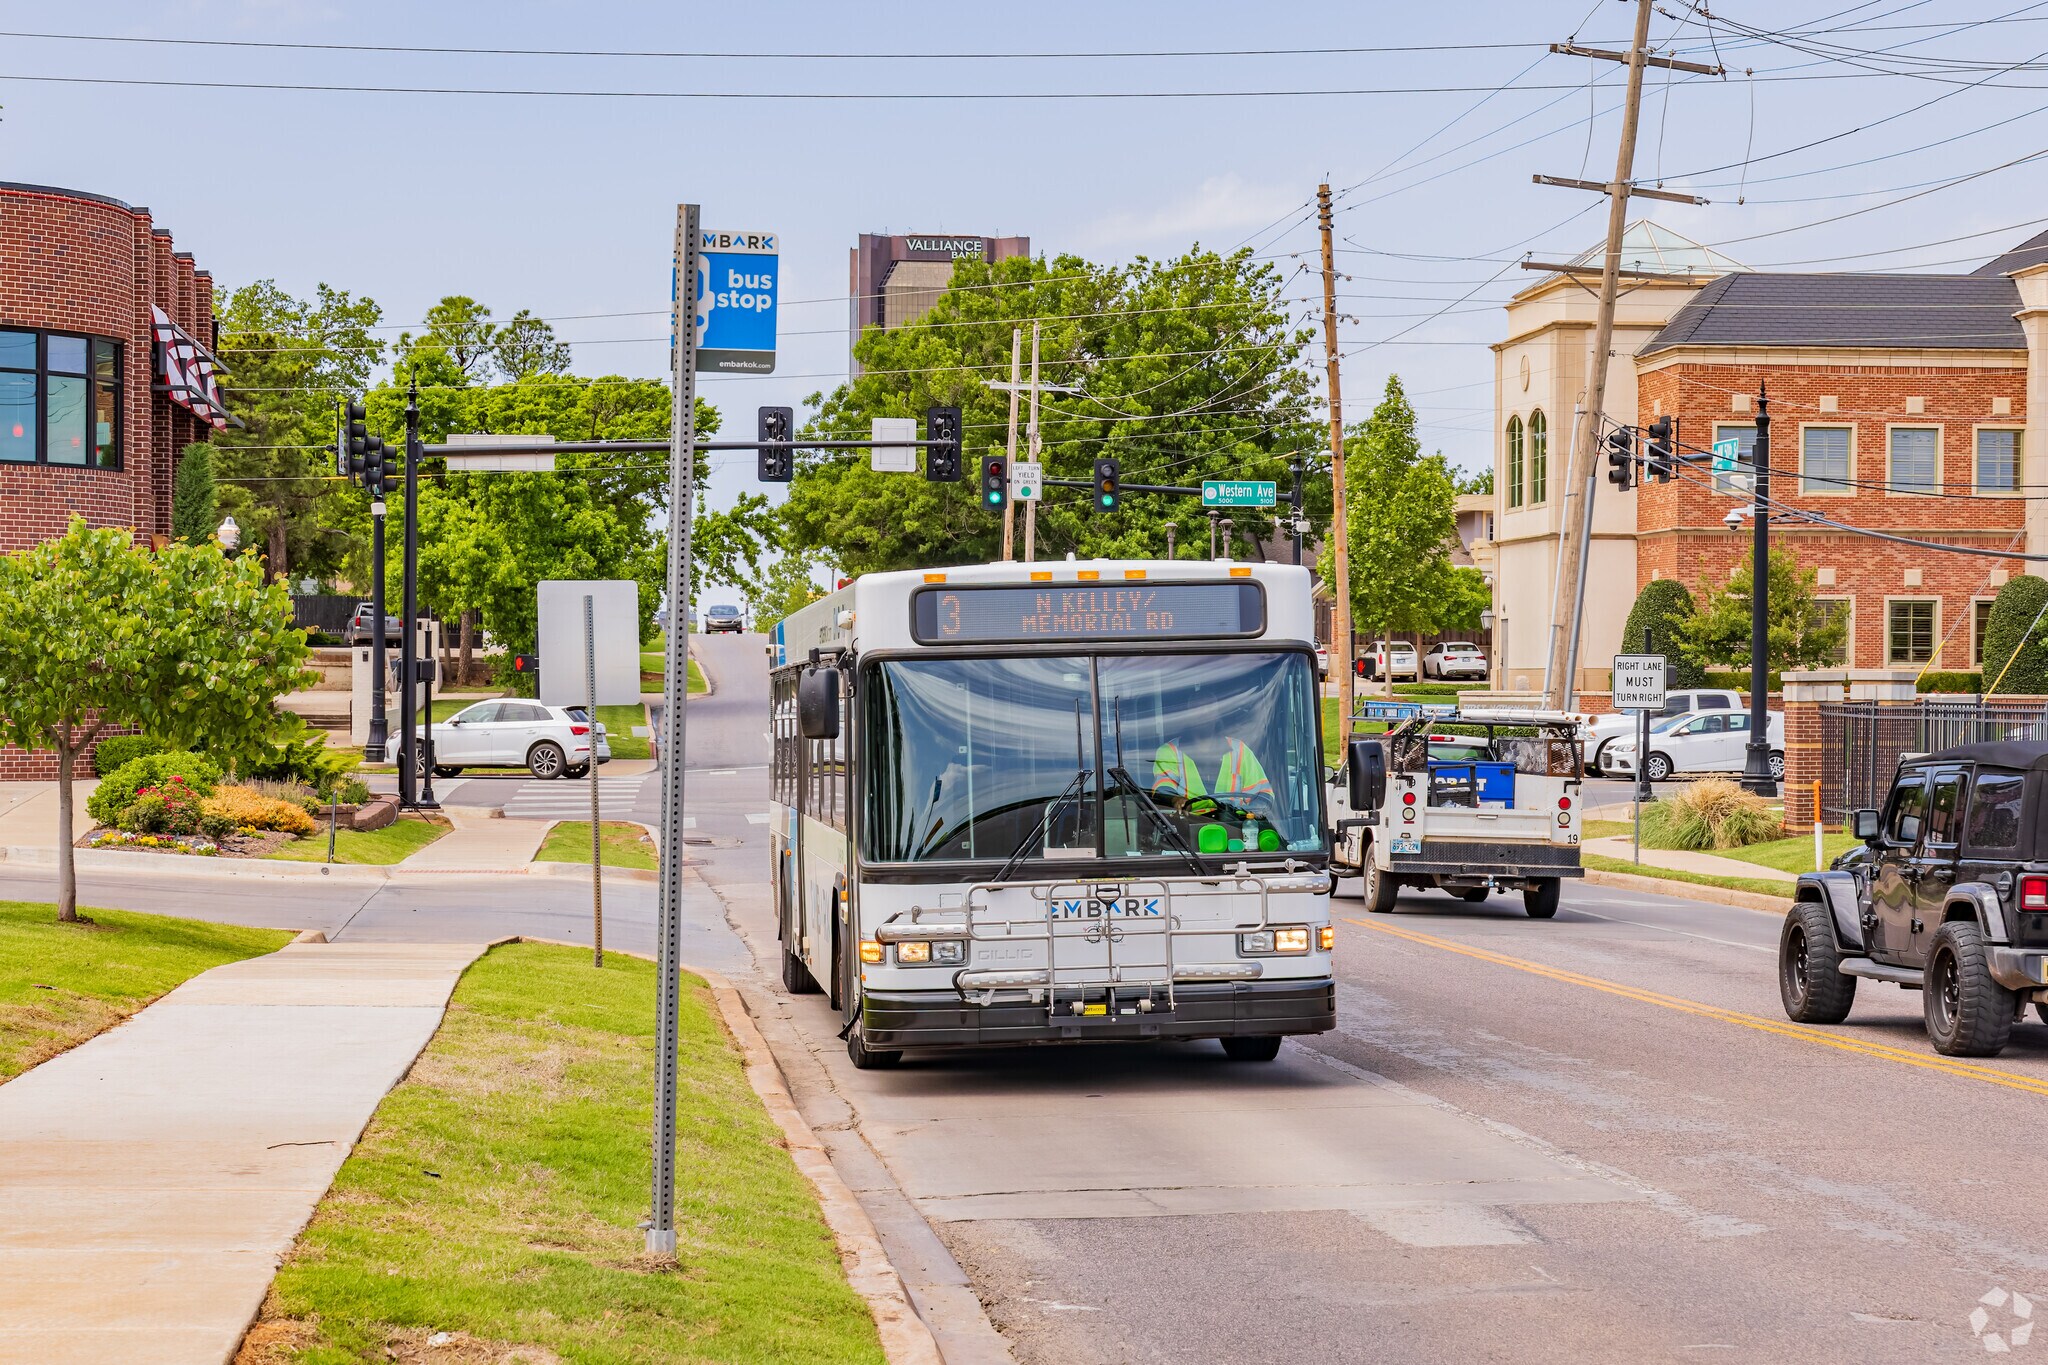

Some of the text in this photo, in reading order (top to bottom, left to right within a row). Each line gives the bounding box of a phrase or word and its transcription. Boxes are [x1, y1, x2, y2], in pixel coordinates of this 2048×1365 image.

[702, 233, 774, 249] MBARK
[906, 239, 981, 251] VALLIANCE
[951, 251, 982, 259] BANK
[728, 268, 773, 289] bus
[717, 290, 772, 313] stop
[719, 360, 771, 369] embarkok.com
[1218, 484, 1274, 497] Western Ave
[1036, 591, 1156, 613] N KELLEY/
[942, 595, 960, 635] 3
[1022, 612, 1173, 633] MEMORIAL RD
[1617, 662, 1662, 670] RIGHT LANE
[1626, 677, 1653, 687] MUST
[1617, 693, 1662, 701] TURN RIGHT
[1568, 834, 1578, 844] 19
[1045, 899, 1158, 918] EMBARK
[978, 949, 1032, 960] GILLIG
